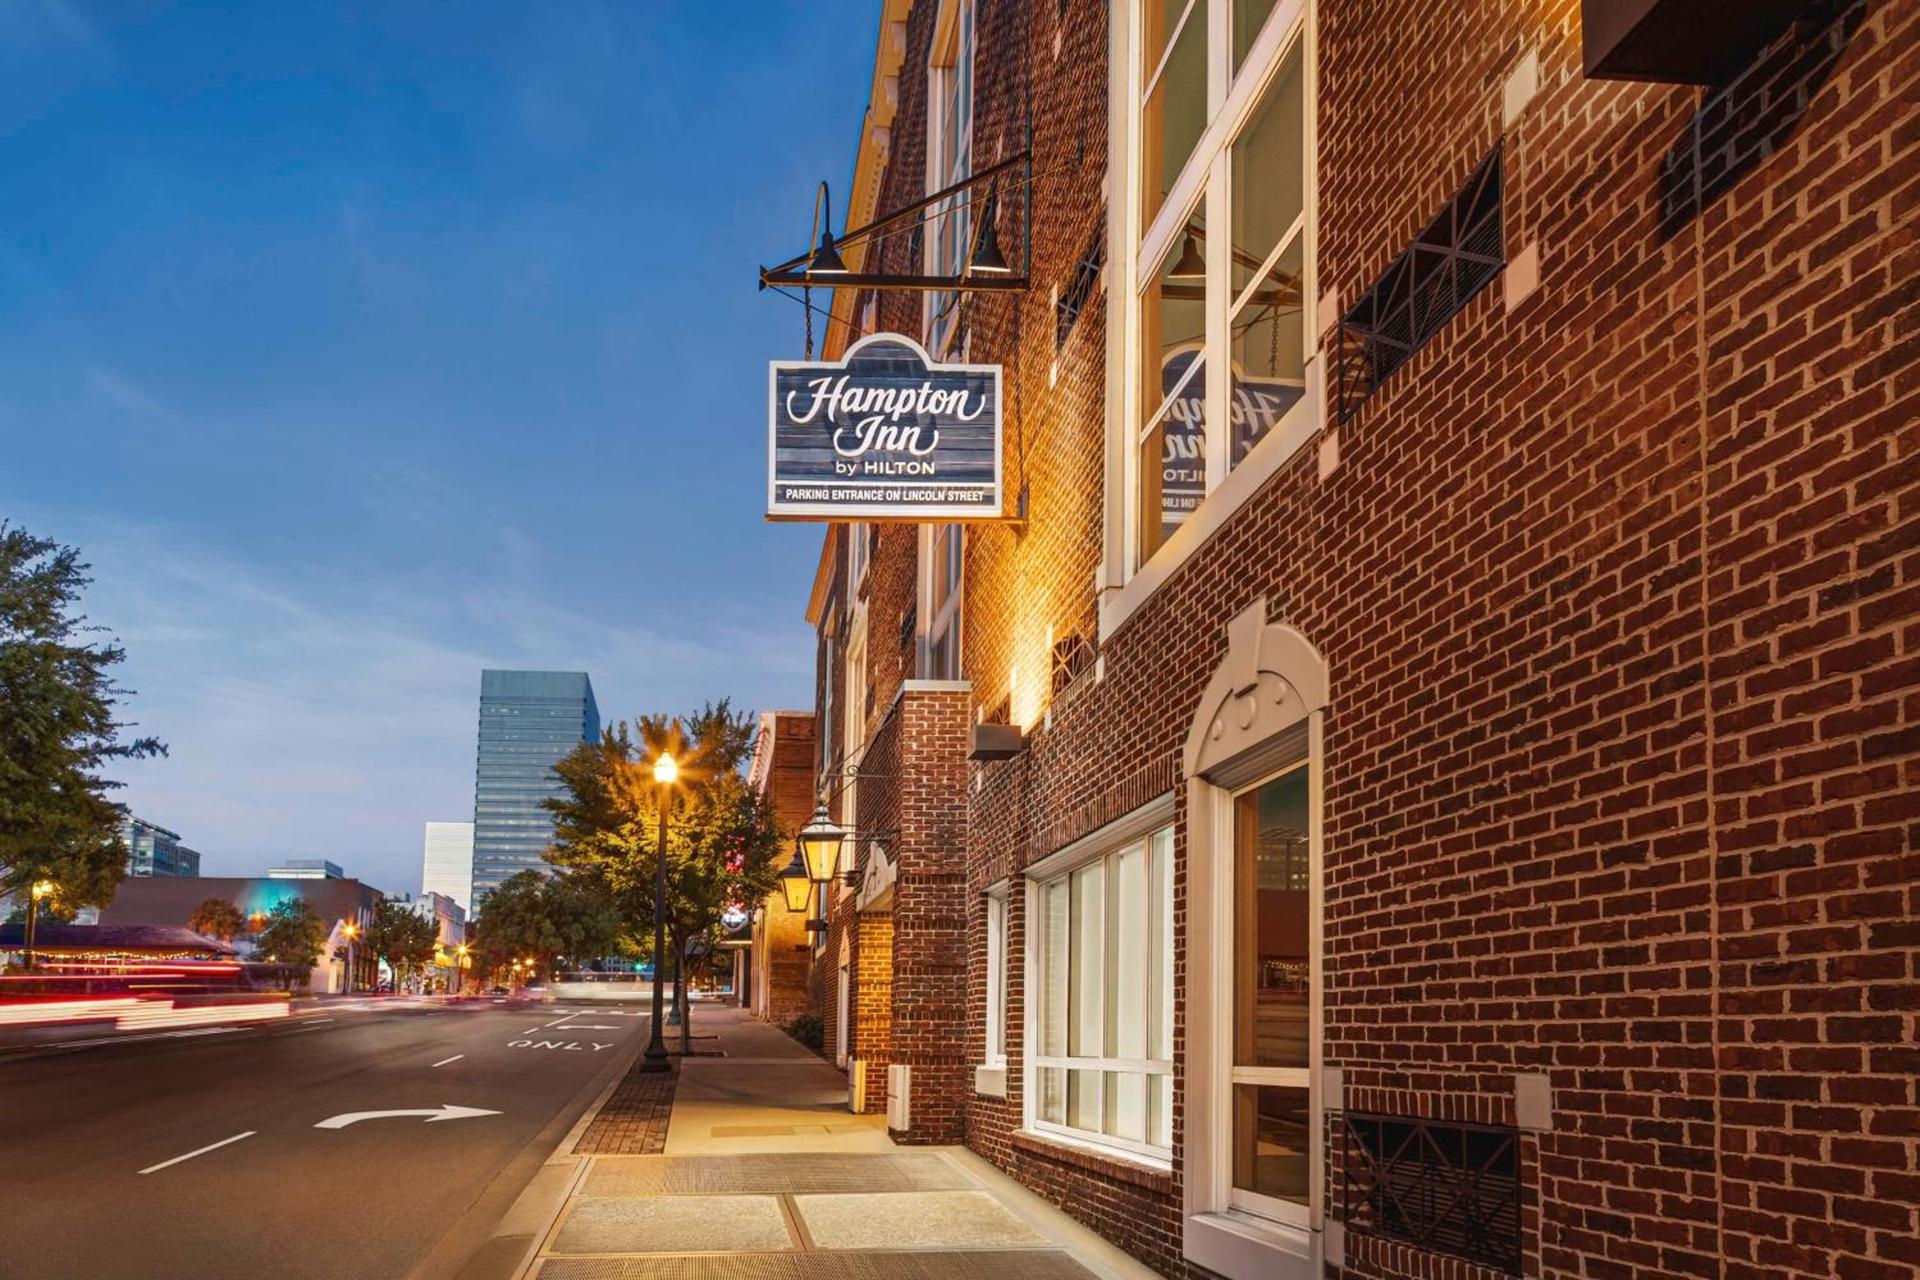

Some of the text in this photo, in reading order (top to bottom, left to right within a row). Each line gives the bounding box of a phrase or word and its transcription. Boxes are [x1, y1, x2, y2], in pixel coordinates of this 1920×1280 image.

[787, 375, 986, 424] Hampton
[833, 415, 939, 457] Inn
[836, 461, 935, 476] by HILTON
[786, 489, 985, 501] PARKING ENTRANCE ON LINCOLN STREET
[507, 1040, 614, 1051] ONLY
